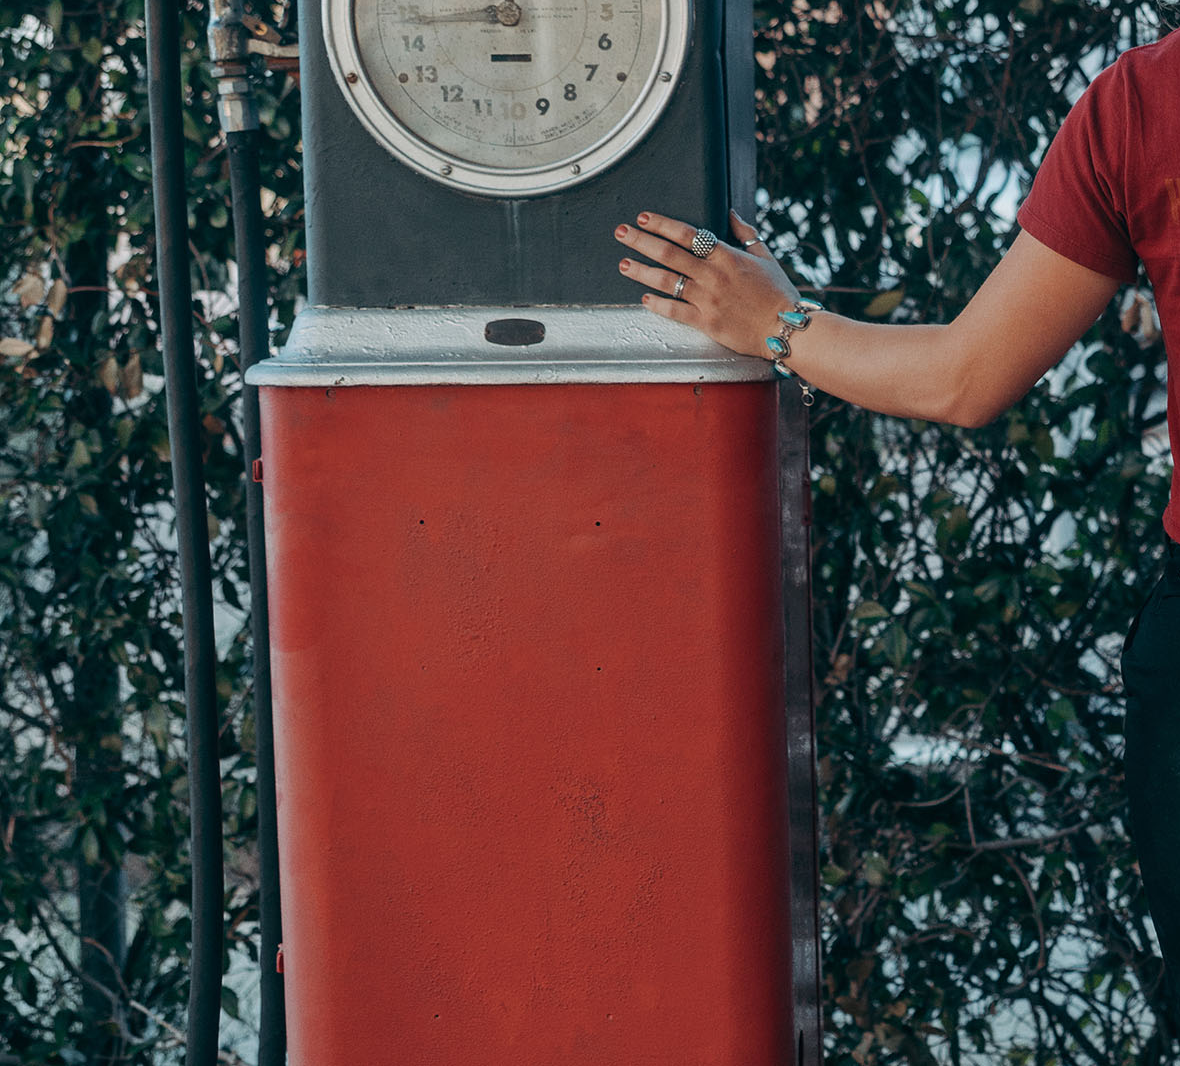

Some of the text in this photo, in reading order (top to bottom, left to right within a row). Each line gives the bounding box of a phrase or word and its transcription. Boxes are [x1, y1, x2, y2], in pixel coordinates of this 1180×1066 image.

[600, 3, 614, 21] 5
[402, 35, 426, 52] 14
[598, 33, 612, 51] 6
[415, 66, 439, 83] 13
[584, 64, 599, 81] 7
[440, 85, 464, 102] 12
[564, 84, 577, 101] 8
[472, 99, 493, 117] 11
[501, 102, 526, 120] 10
[535, 98, 550, 115] 9
